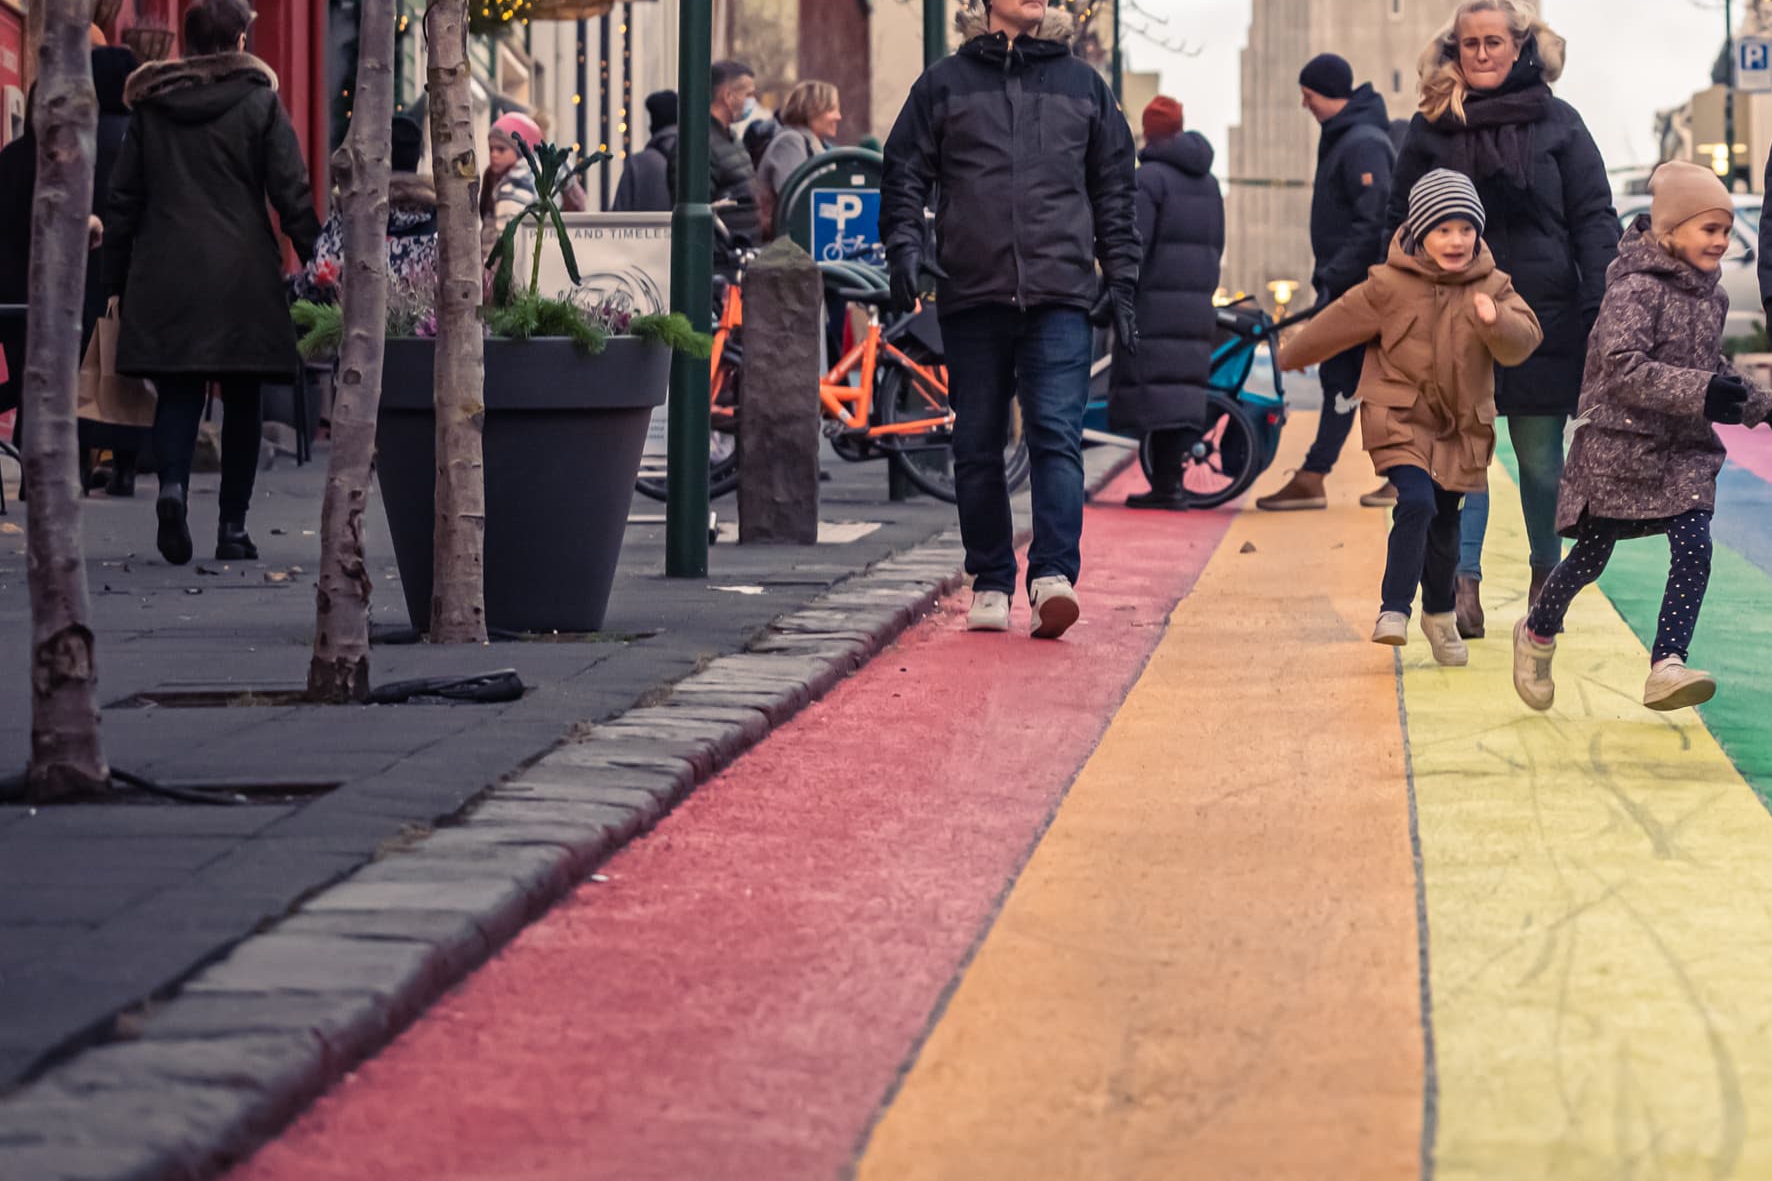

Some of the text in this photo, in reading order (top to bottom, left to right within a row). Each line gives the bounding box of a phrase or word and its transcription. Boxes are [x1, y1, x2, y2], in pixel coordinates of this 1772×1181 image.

[1745, 43, 1764, 69] P
[836, 193, 863, 231] P
[529, 227, 671, 240] PUR AND TIMELES
